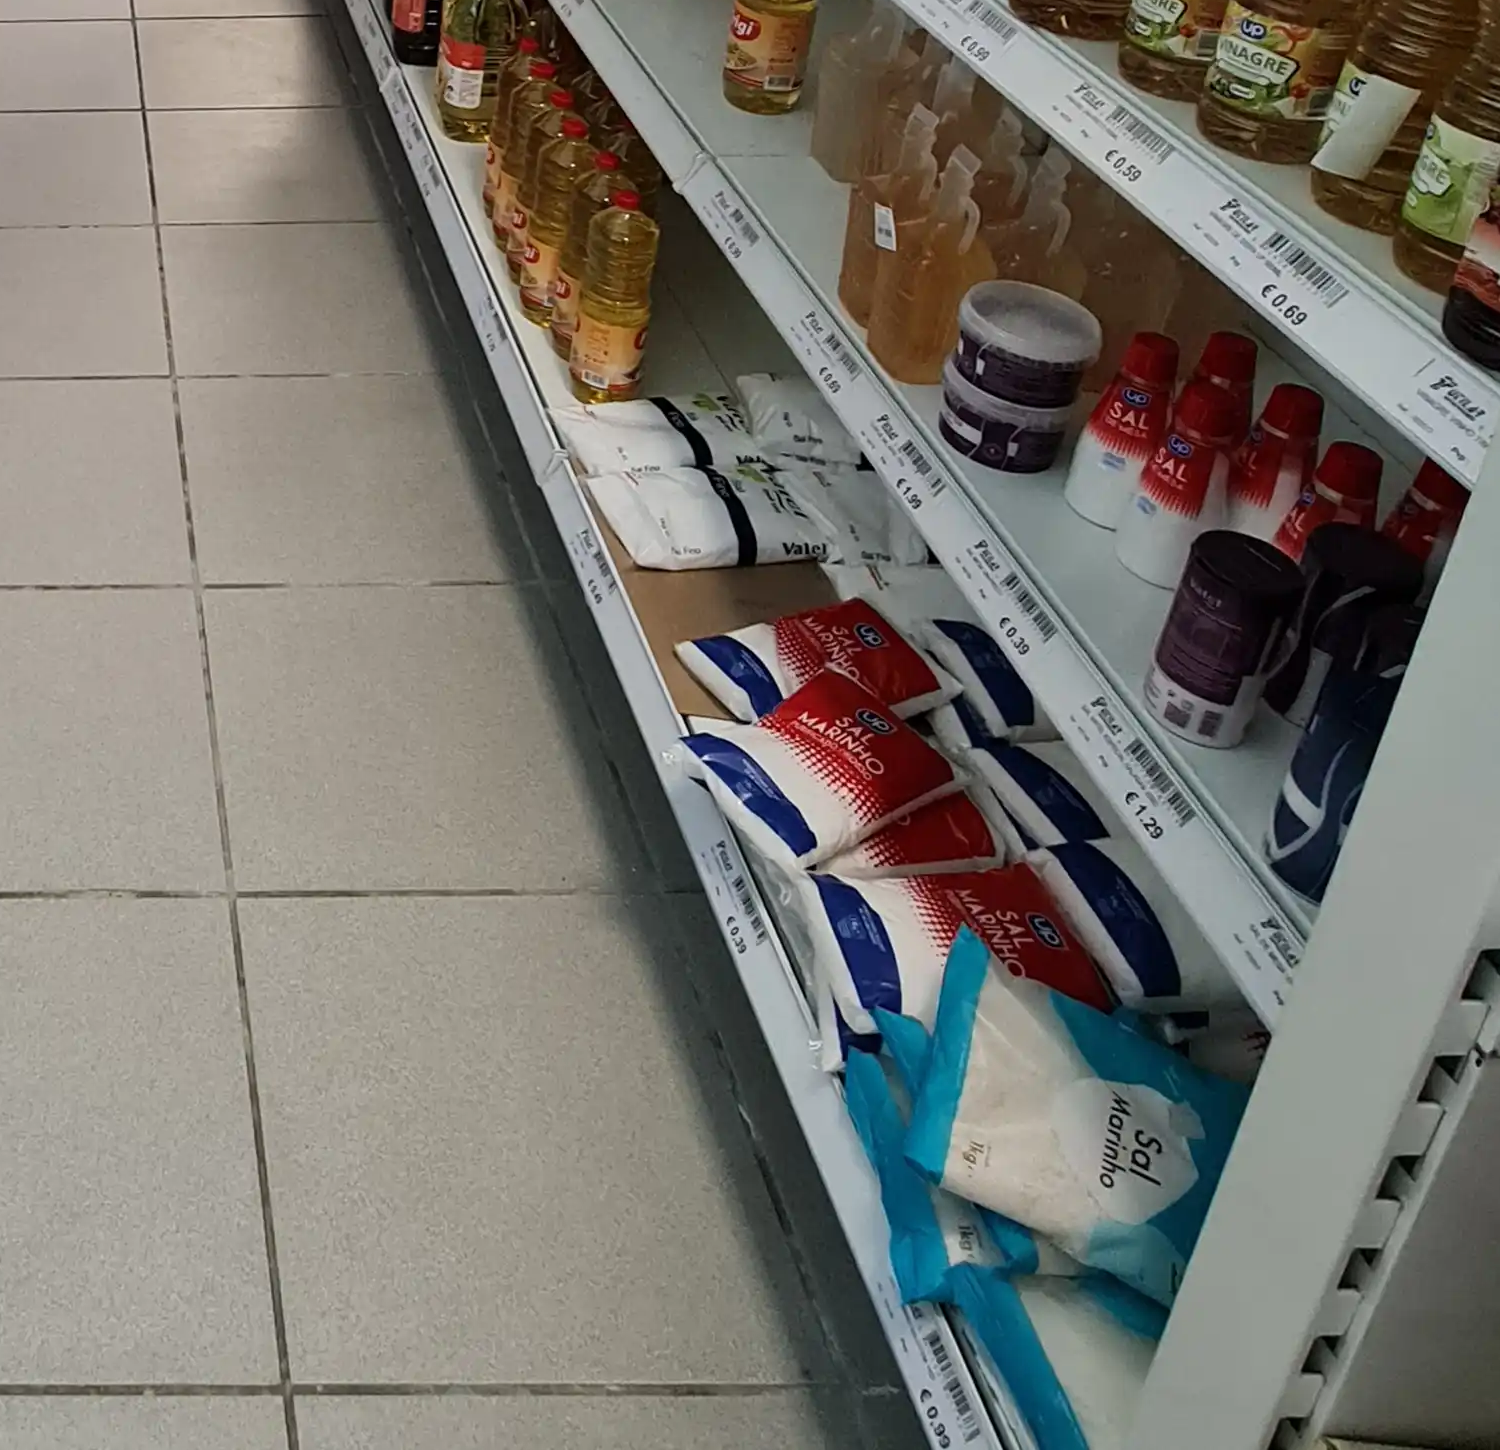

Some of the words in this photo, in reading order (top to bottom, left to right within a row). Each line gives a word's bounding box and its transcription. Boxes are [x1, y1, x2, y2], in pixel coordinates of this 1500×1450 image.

[1105, 150, 1118, 164] €
[1261, 284, 1276, 299] €
[1274, 293, 1308, 327] 0.69
[1109, 401, 1150, 430] SAL
[1155, 446, 1188, 483] SAL
[1000, 617, 1011, 630] €
[1005, 625, 1031, 656] 0.39
[831, 625, 862, 657] SAL
[798, 712, 884, 777] MARINHO
[835, 715, 875, 747] SAL
[1125, 791, 1138, 806] €
[1134, 802, 1164, 841] 1.29
[729, 925, 748, 954] 0.39
[996, 910, 1034, 948] SAL
[1098, 1090, 1134, 1190] Marinho
[1132, 1126, 1166, 1188] Sal
[920, 1387, 935, 1406] €
[927, 1405, 953, 1450] 0.99
